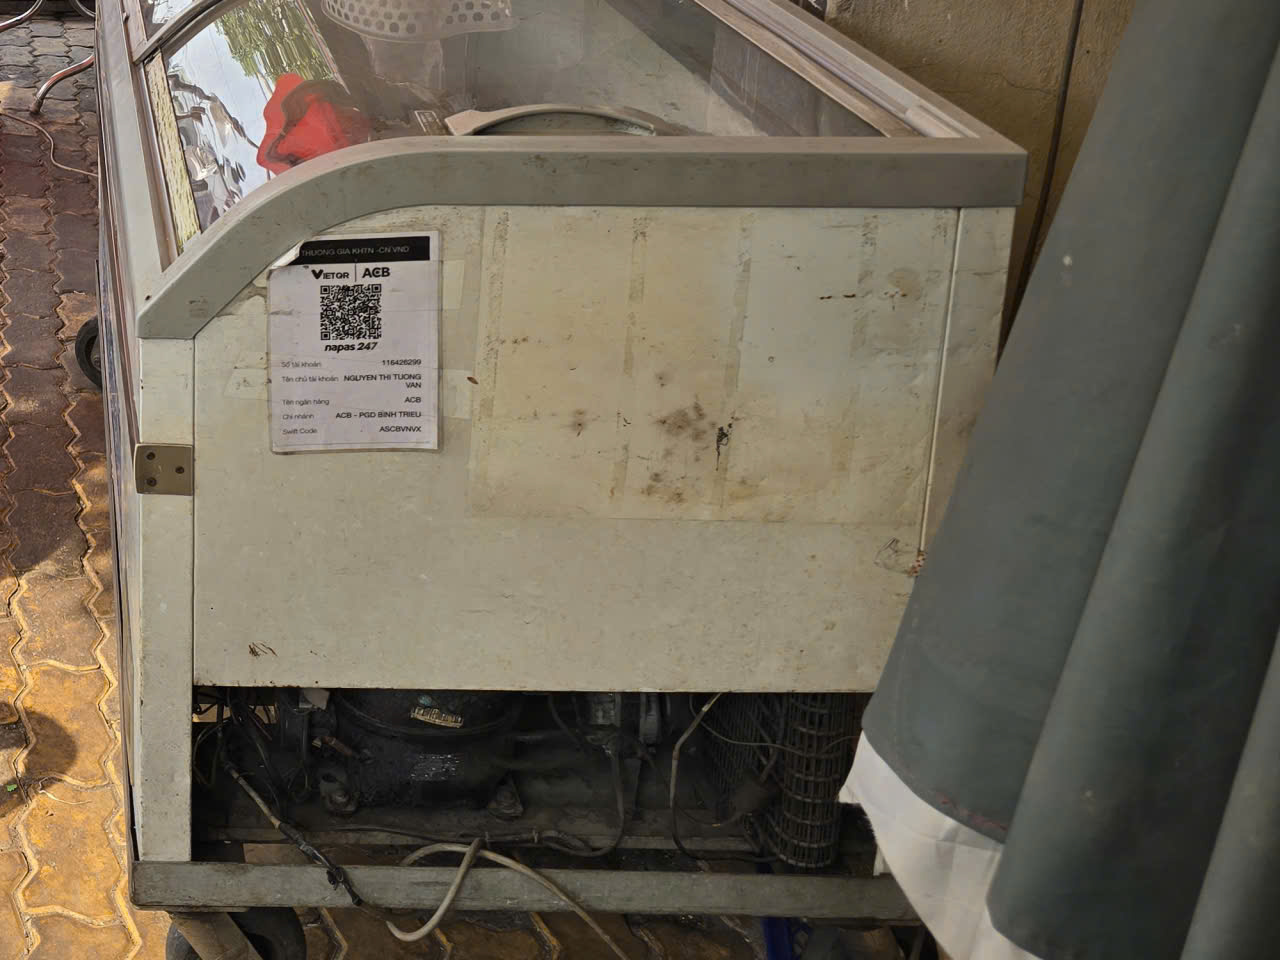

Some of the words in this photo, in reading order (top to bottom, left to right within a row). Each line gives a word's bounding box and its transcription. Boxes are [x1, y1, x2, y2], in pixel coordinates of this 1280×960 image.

[362, 267, 391, 279] ACB
[324, 342, 356, 354] napas
[357, 341, 378, 351] 247
[343, 374, 377, 382] NGUYEN
[394, 373, 422, 381] TUONG
[405, 381, 422, 389] VAN
[404, 396, 422, 404] ACB
[335, 411, 352, 419] ACB
[359, 411, 376, 419] PGD
[398, 411, 422, 419] TRIEU
[300, 427, 318, 435] Code
